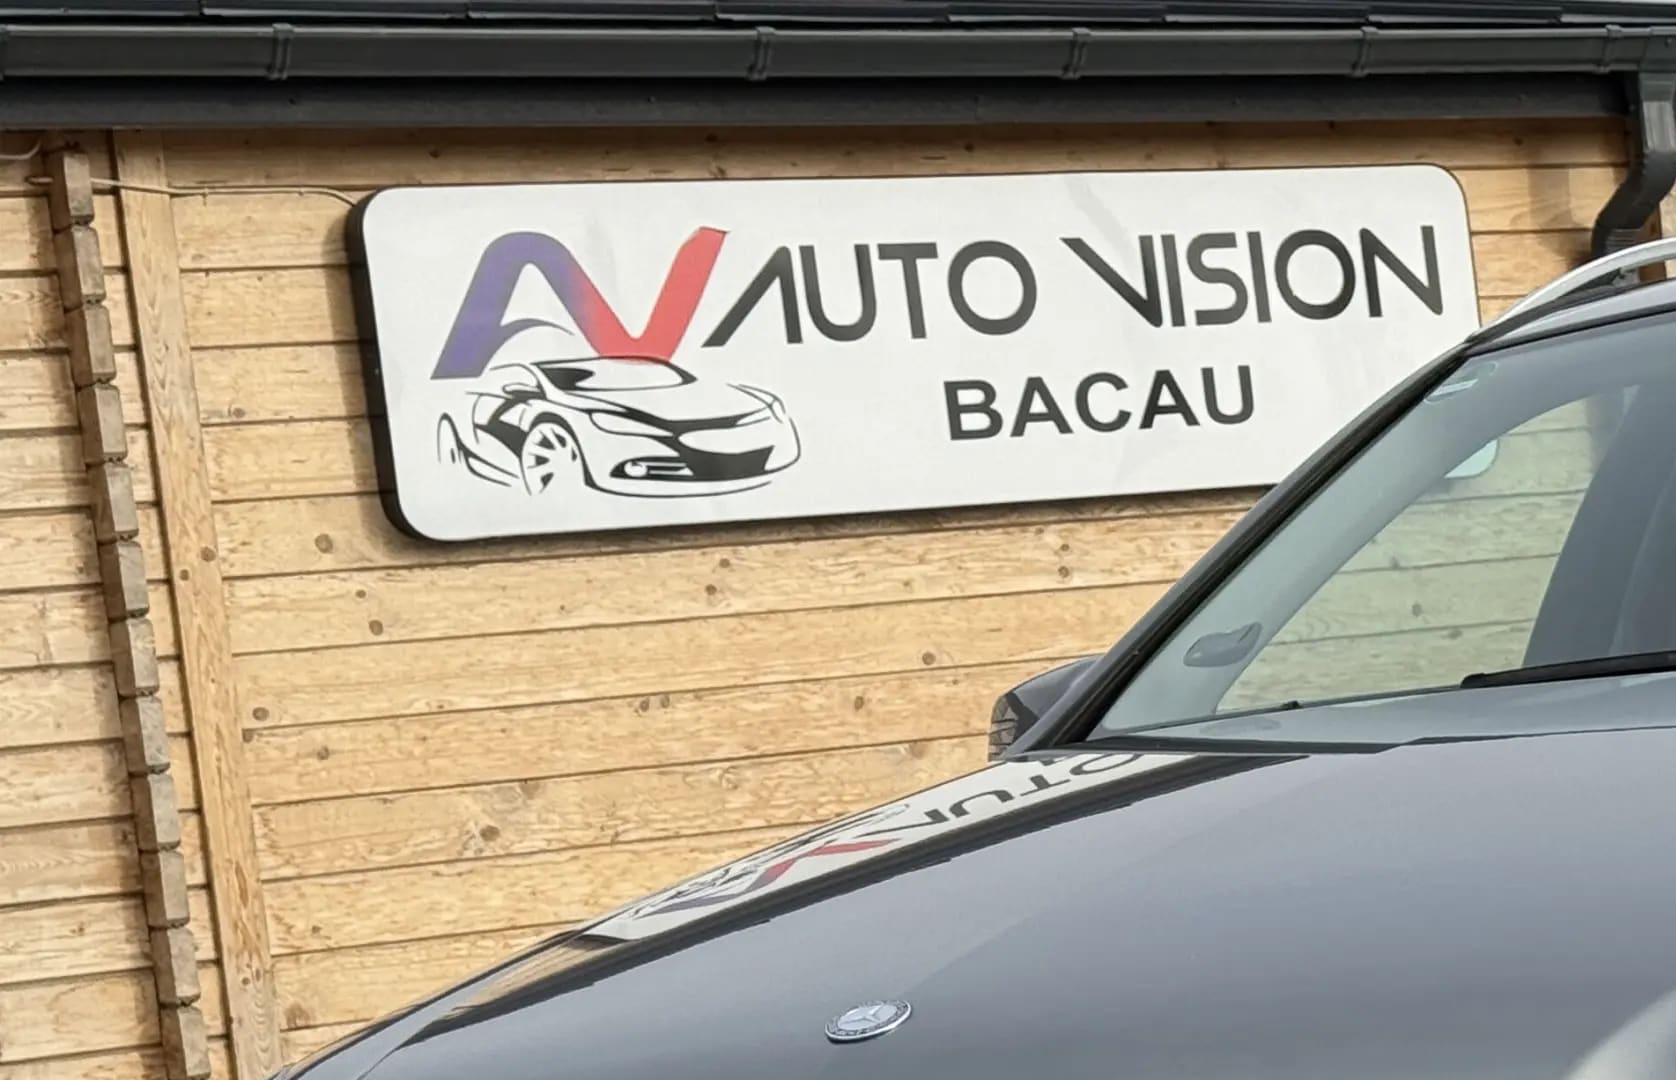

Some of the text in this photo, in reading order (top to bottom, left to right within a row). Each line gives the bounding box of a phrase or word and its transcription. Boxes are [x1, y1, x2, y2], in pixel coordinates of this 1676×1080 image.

[701, 225, 1443, 347] AUTO VISION
[943, 365, 1255, 441] BACAU
